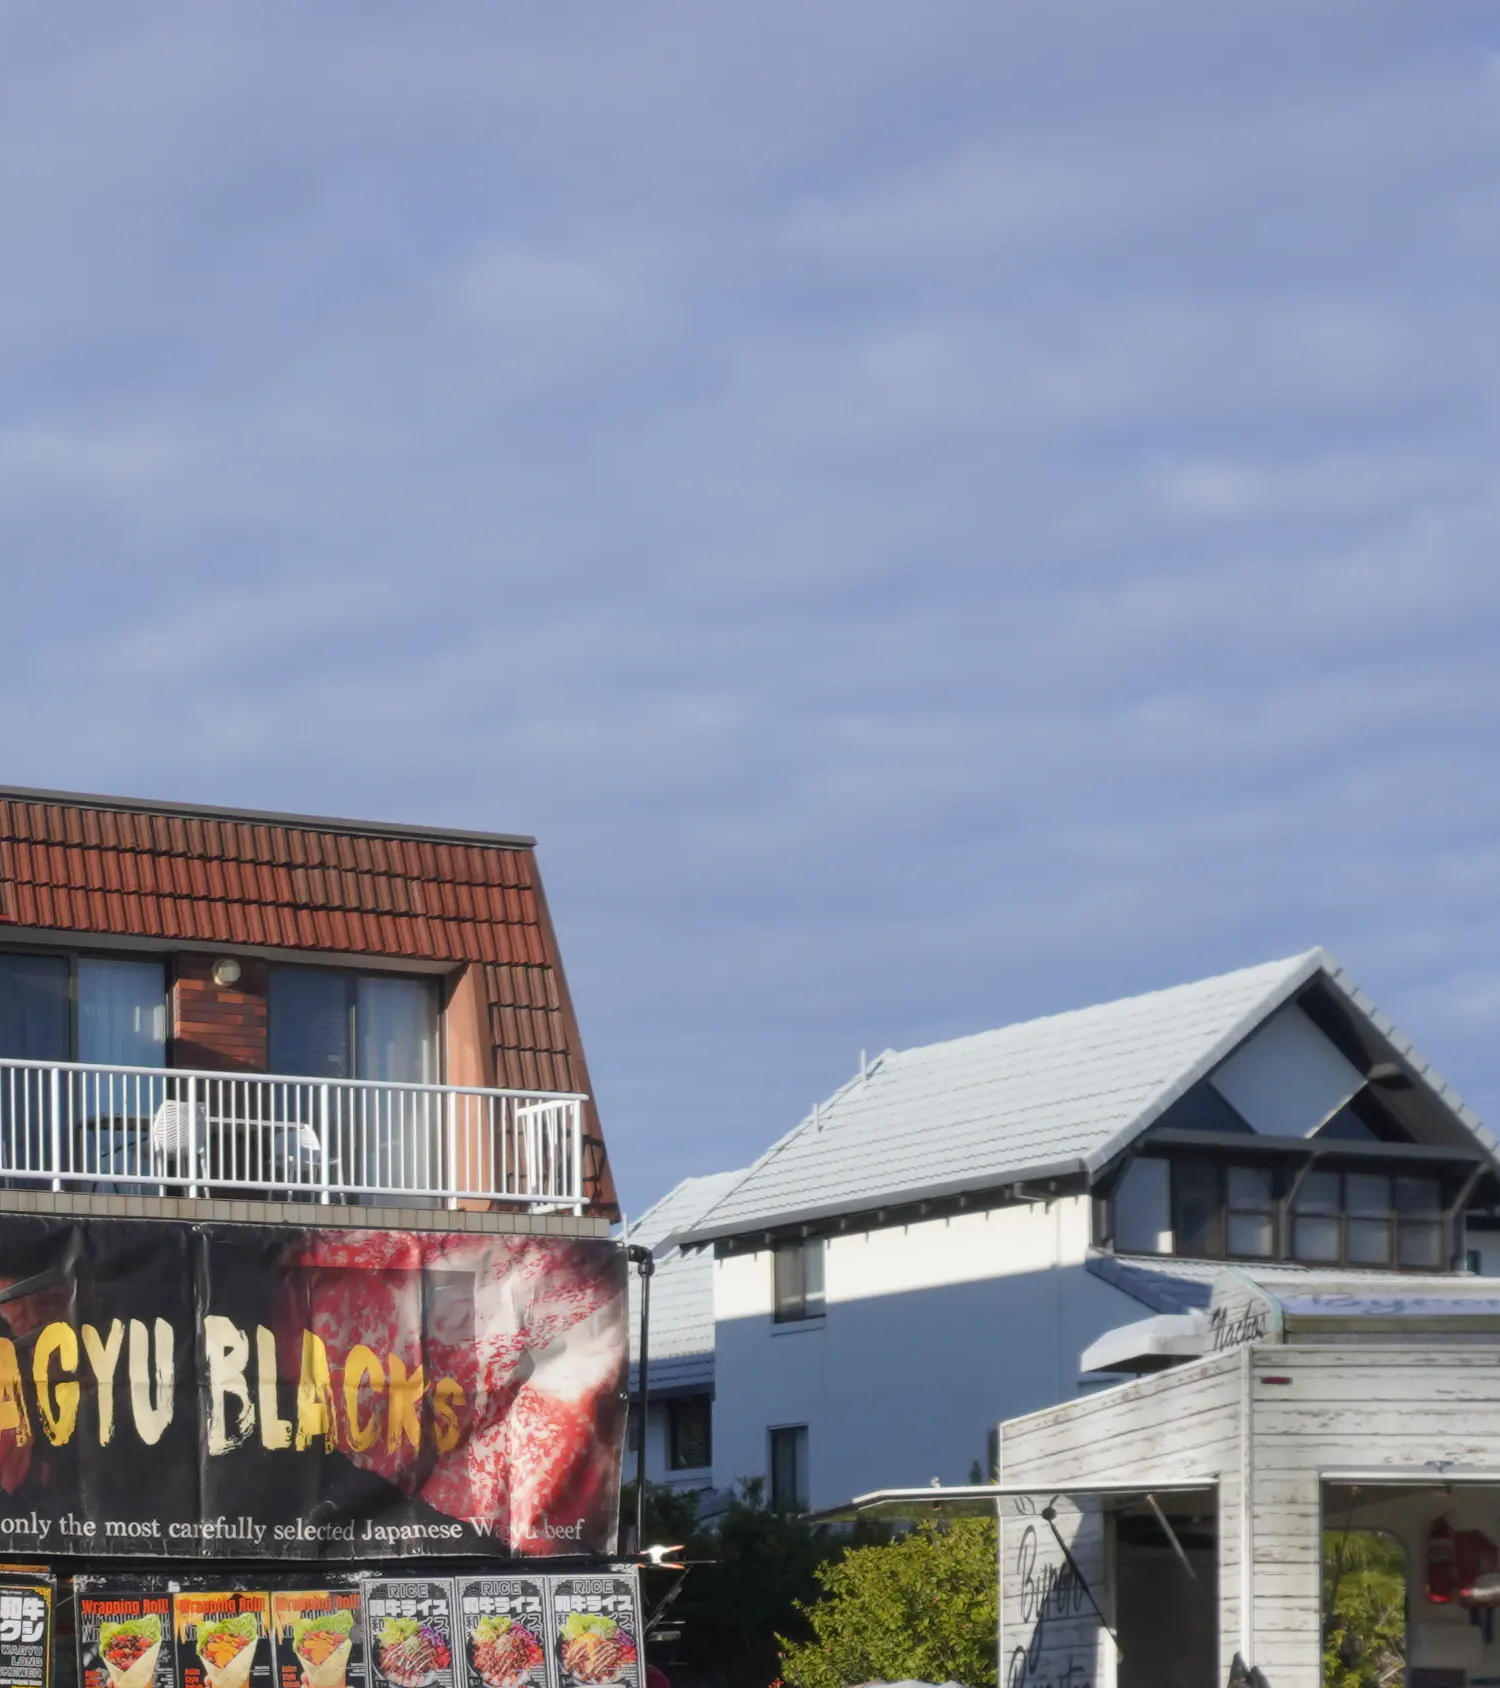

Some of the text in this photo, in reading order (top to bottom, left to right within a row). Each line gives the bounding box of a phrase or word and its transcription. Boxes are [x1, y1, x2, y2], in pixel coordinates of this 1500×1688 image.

[203, 1315, 468, 1456] BLACKS
[0, 1512, 52, 1538] only
[59, 1512, 97, 1537] the
[104, 1518, 162, 1538] most
[168, 1516, 267, 1543] carefully
[274, 1517, 355, 1541] selected
[361, 1518, 463, 1545] Japanese
[471, 1516, 539, 1545] Wagyu
[542, 1518, 586, 1540] beef
[388, 1584, 429, 1598] RICE
[480, 1582, 522, 1596] RICE
[573, 1580, 614, 1594] RICE
[81, 1600, 140, 1615] Wrapping
[1, 1645, 43, 1655] WAGYU
[11, 1656, 42, 1667] LONG
